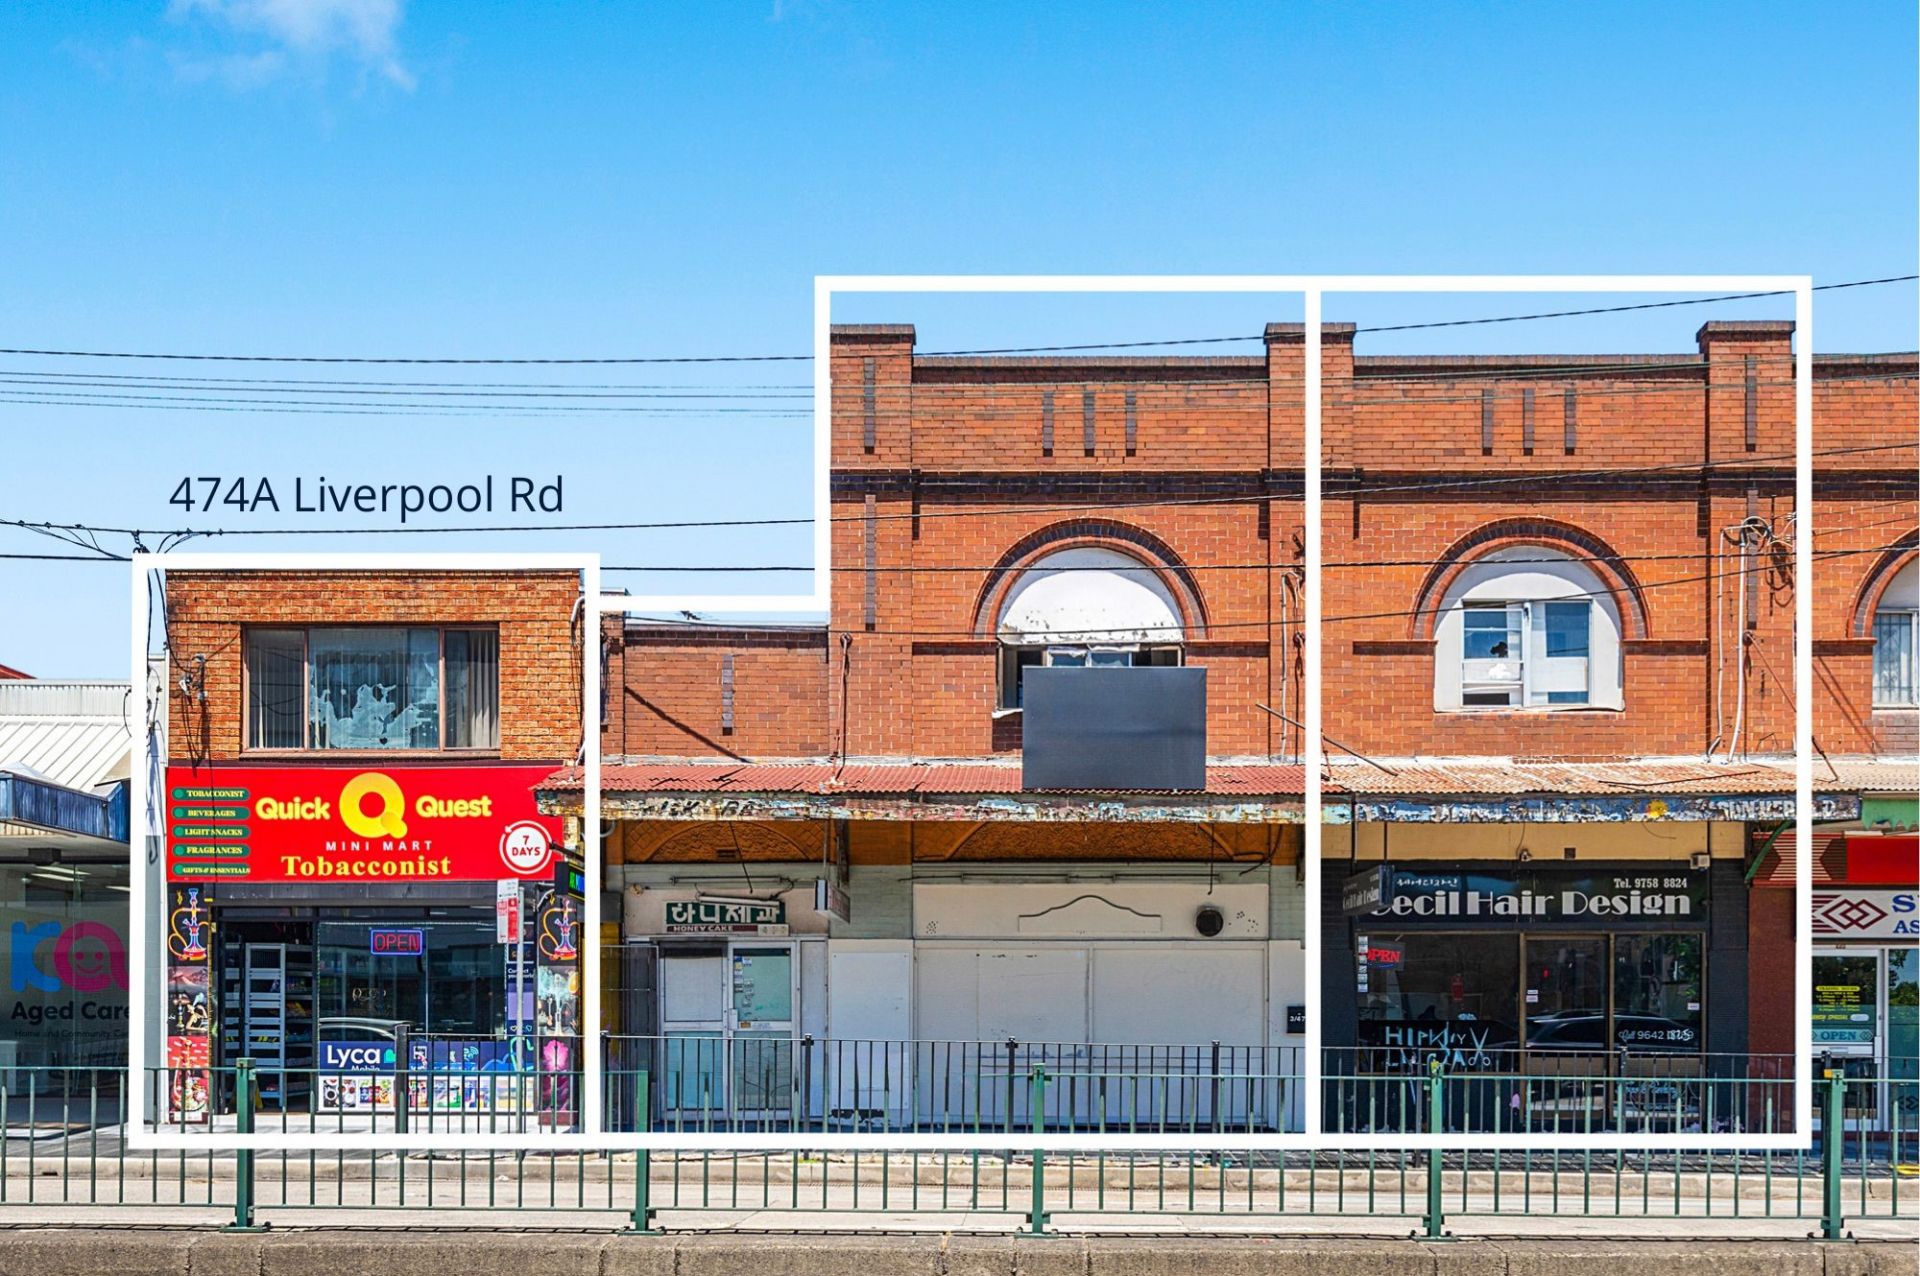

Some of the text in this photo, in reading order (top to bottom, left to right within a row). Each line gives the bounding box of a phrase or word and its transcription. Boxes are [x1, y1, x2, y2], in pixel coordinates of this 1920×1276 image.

[187, 790, 245, 798] TOBACCONIST
[256, 796, 331, 821] Quick
[415, 795, 493, 819] Quest
[187, 809, 237, 817] BEVERAGES
[184, 828, 243, 836] LIGHT SNACKS
[326, 840, 434, 852] MINI MART
[523, 835, 531, 846] 7
[186, 846, 243, 854] FRAGRANCES
[511, 846, 541, 857] DAYS
[281, 854, 452, 878] Tobacconist
[1613, 878, 1688, 889] Tel. 9758 8824
[1371, 889, 1460, 916] ecil
[1466, 889, 1554, 916] Hair
[1561, 890, 1691, 916] Design
[1892, 894, 1919, 913] S
[374, 933, 420, 952] OPEN
[11, 1000, 74, 1025] Aged
[1637, 1030, 1665, 1040] 9642
[1820, 1031, 1857, 1041] OPEN
[326, 1044, 381, 1068] Lyca
